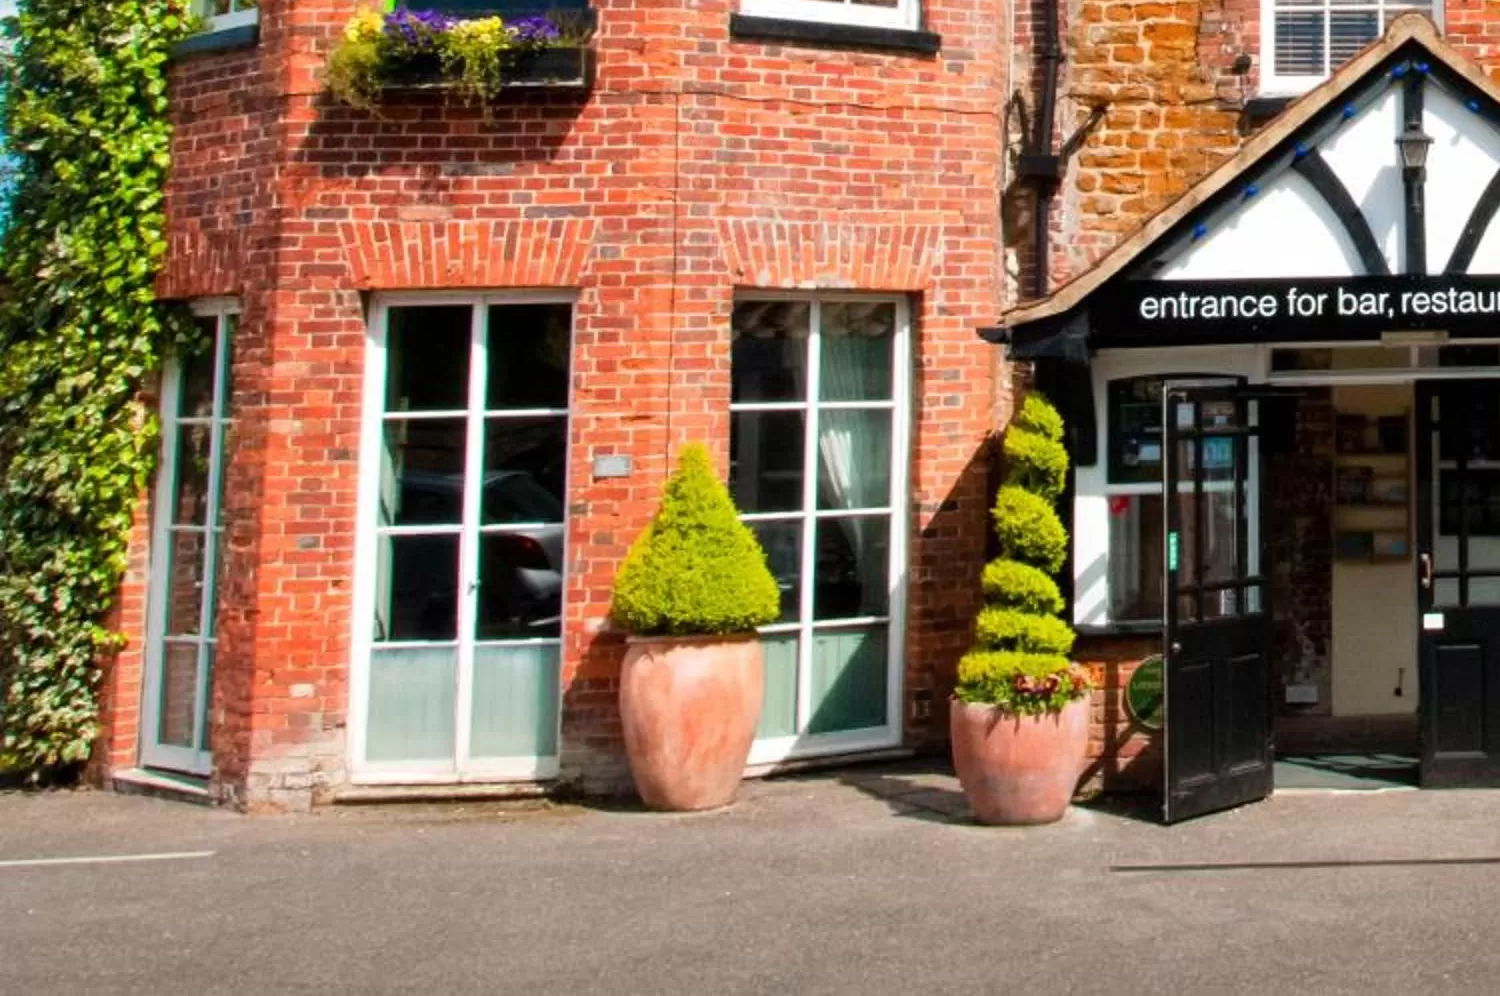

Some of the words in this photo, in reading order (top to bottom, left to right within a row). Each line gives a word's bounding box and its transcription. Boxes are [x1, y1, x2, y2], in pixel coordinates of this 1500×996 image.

[1139, 291, 1278, 319] entrance
[1286, 287, 1329, 317] for
[1337, 287, 1394, 318] bar,
